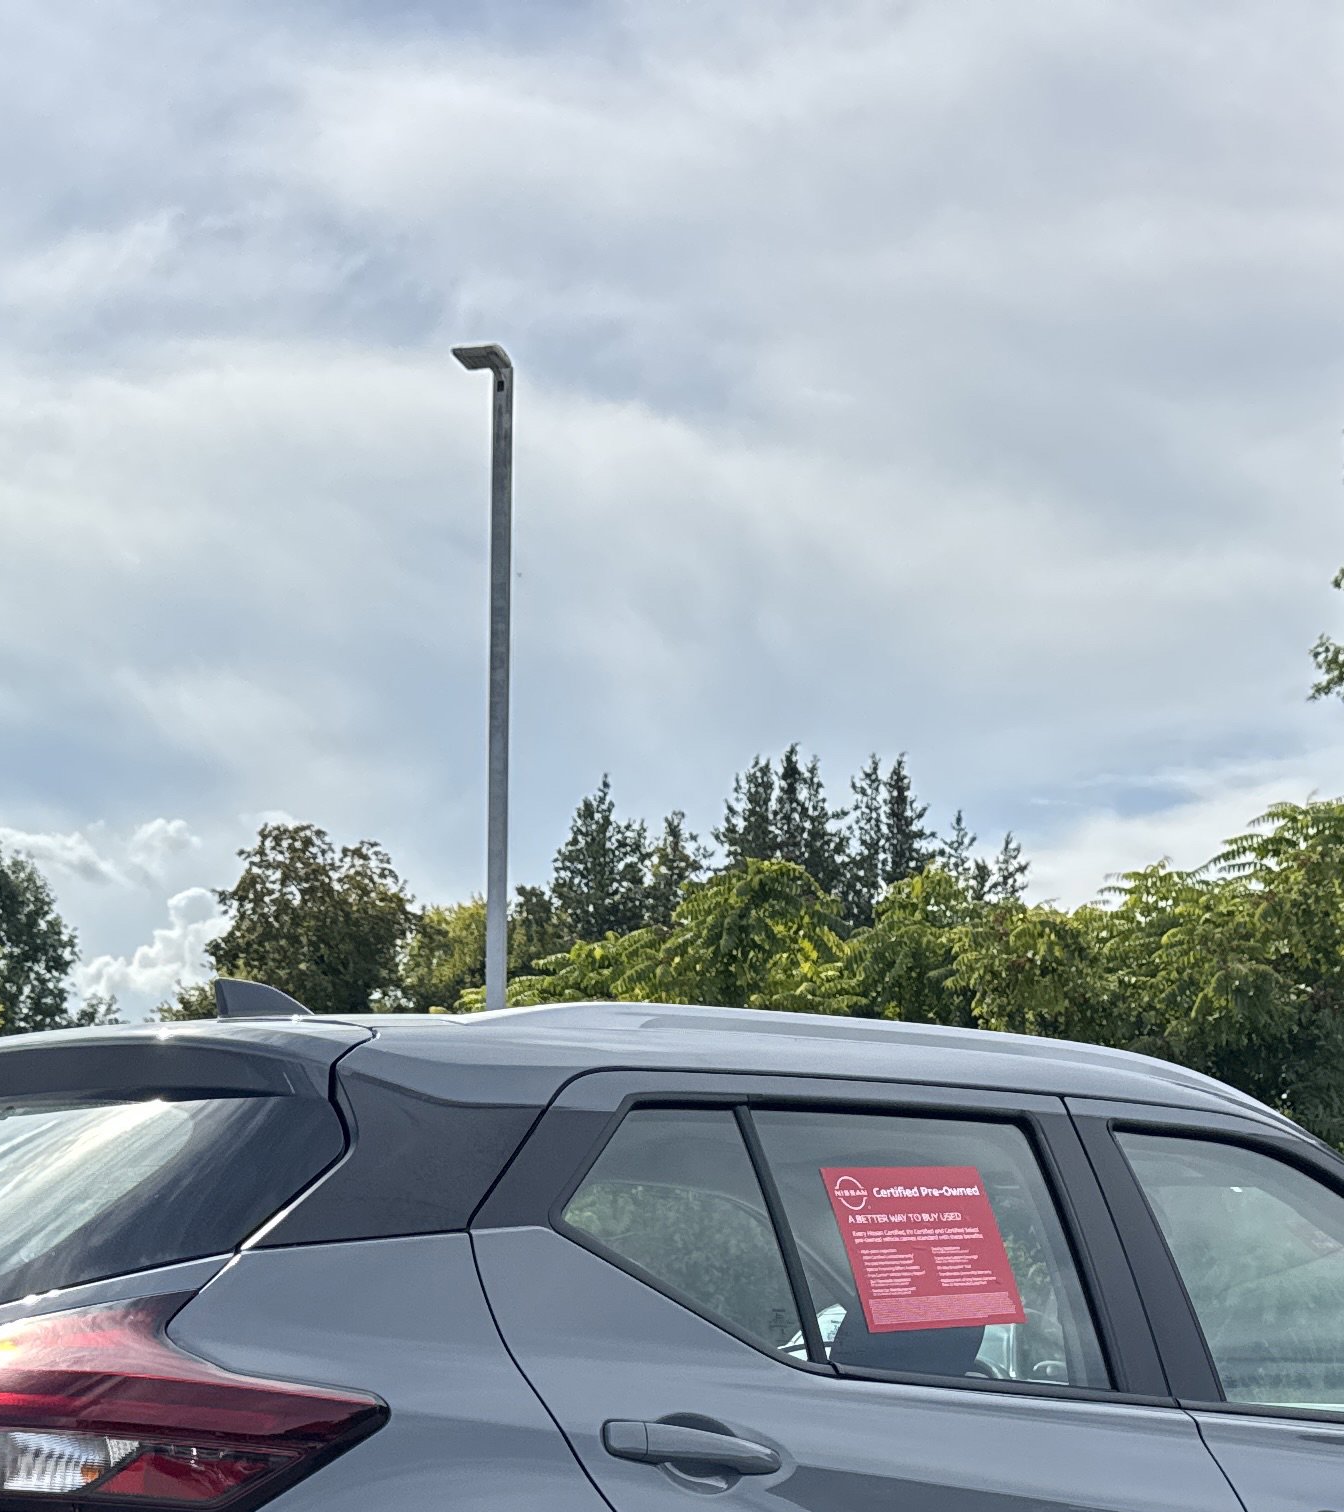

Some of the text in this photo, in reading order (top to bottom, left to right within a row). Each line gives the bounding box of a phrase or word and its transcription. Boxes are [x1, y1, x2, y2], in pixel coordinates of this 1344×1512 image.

[834, 1189, 868, 1197] NISSAN
[872, 1185, 980, 1198] Certified Pre-Owned
[848, 1212, 962, 1224] A BETTER WAY TO BUY USED
